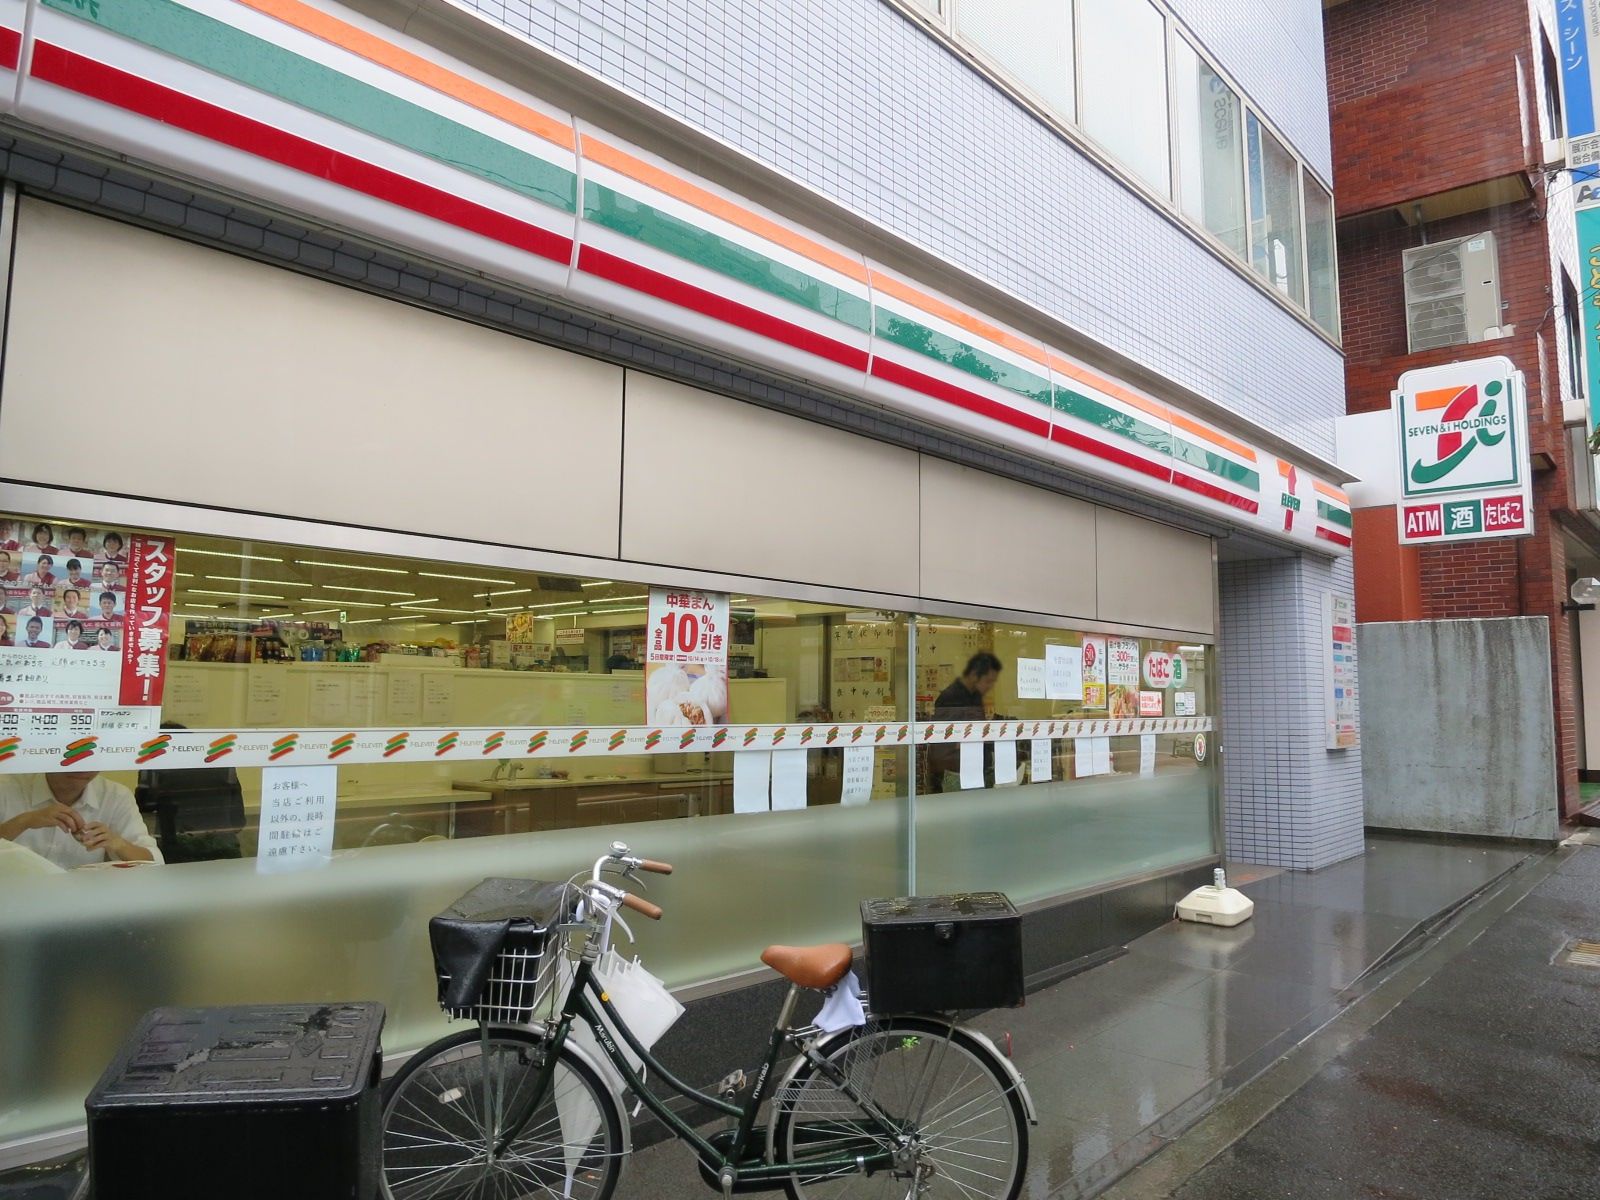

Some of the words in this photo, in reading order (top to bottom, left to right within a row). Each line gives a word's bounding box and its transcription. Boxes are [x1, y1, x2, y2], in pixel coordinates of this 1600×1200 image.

[1453, 414, 1507, 431] HOLDINGS
[1407, 509, 1440, 534] ATM
[1451, 506, 1474, 530] 酒
[1485, 502, 1522, 526] たばこ
[666, 593, 715, 611] 中華まん
[1148, 656, 1170, 679] たばこ
[1172, 659, 1182, 680] 酒
[272, 780, 308, 790] お客様へ
[272, 795, 324, 807] 当店ご利用
